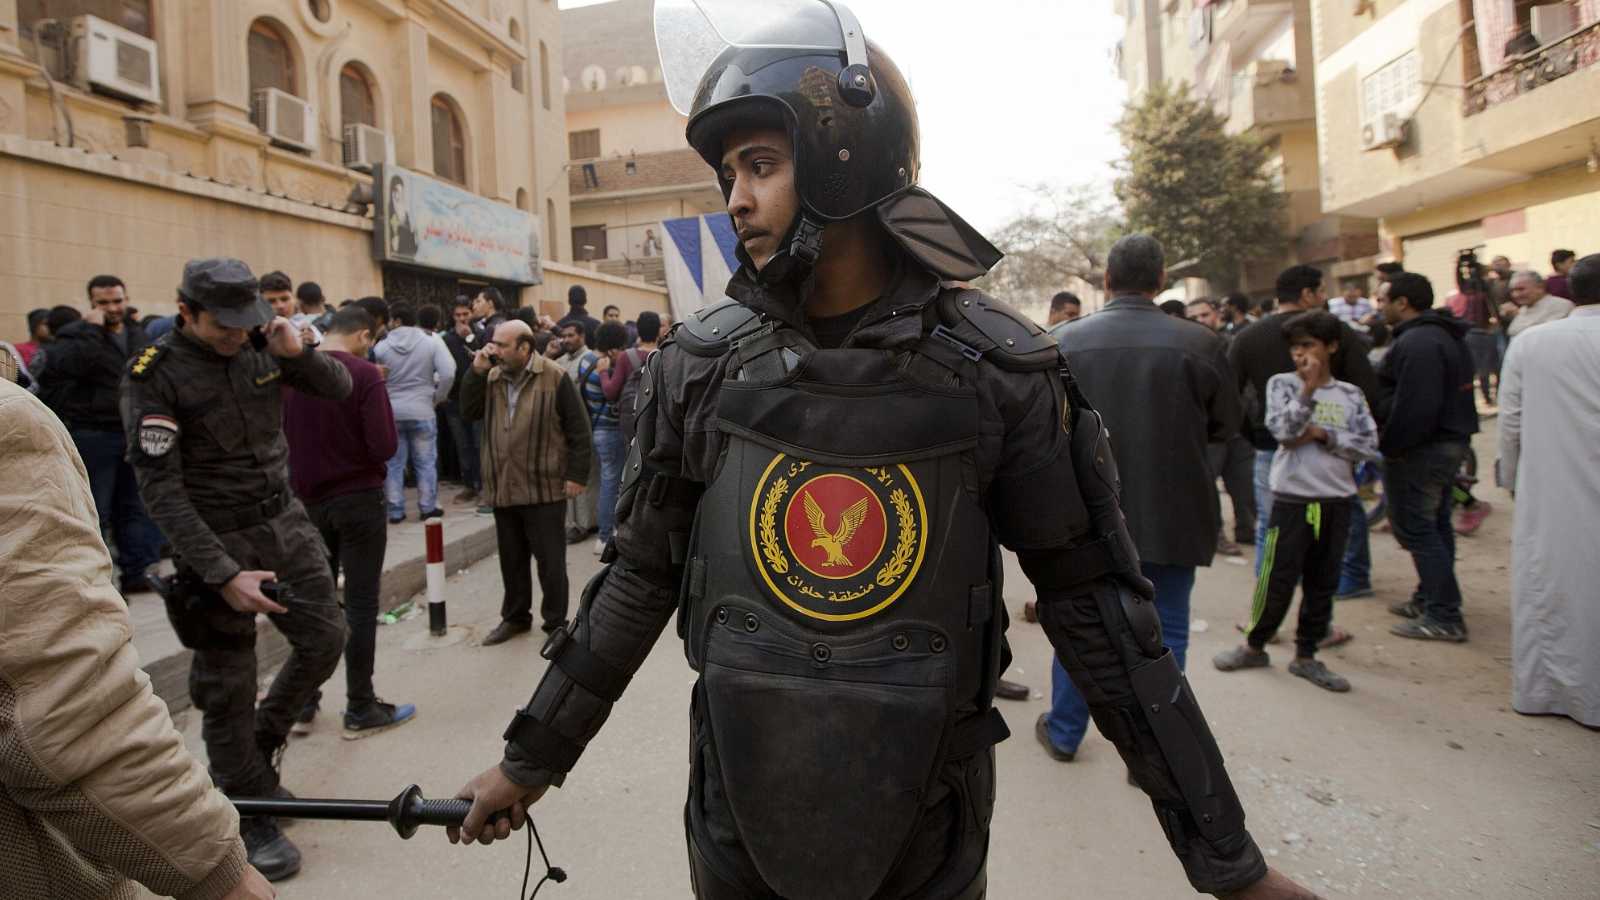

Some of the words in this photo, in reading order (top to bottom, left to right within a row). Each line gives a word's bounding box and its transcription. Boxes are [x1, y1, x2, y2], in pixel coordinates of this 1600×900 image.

[854, 465, 894, 487] الأم
[787, 575, 825, 599] حلوان
[828, 583, 875, 602] منطقة
